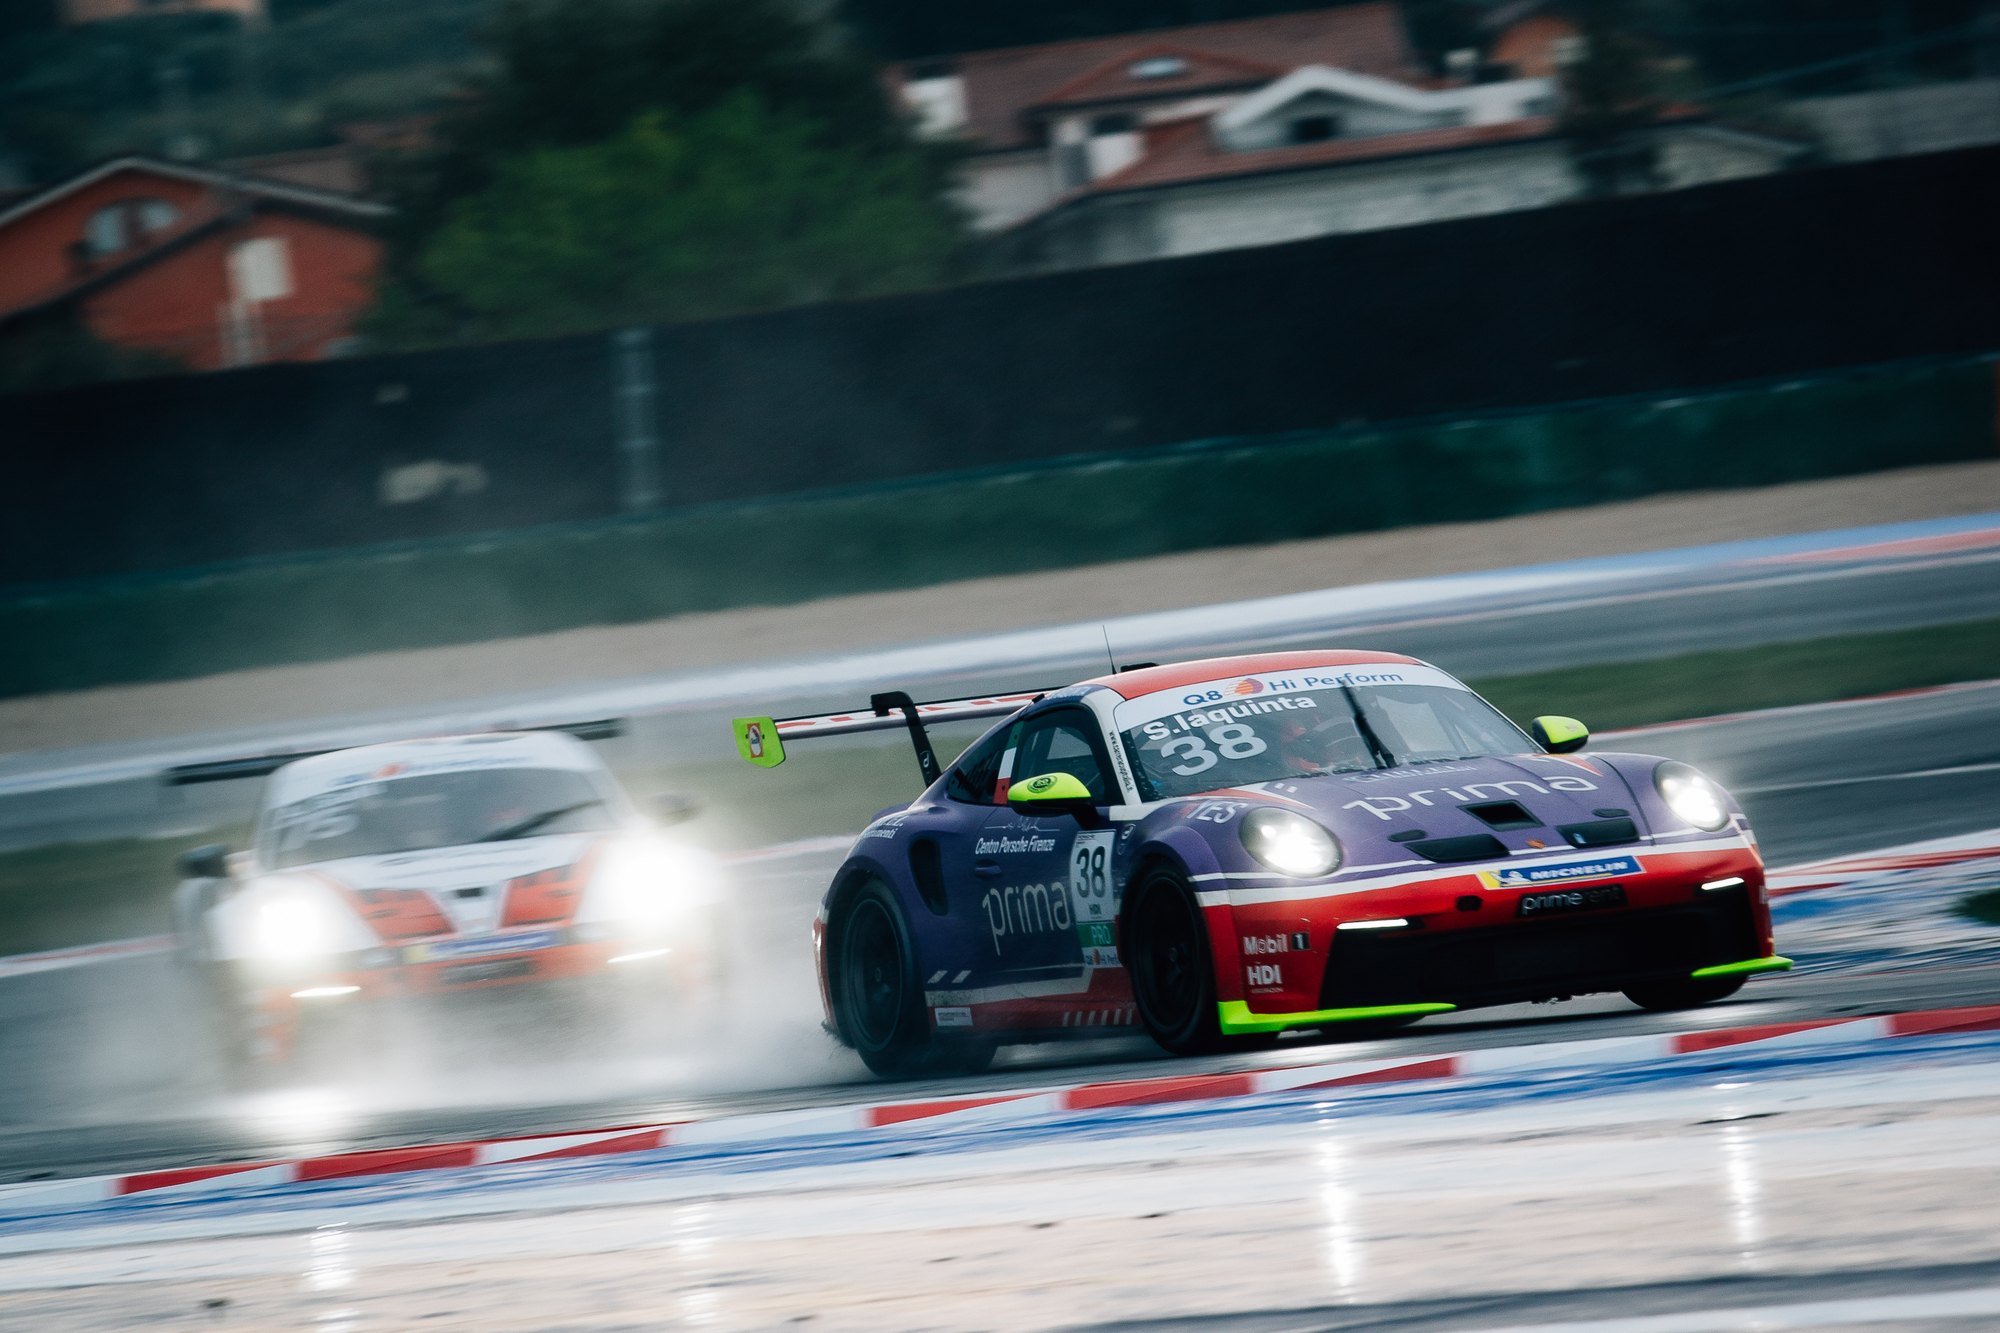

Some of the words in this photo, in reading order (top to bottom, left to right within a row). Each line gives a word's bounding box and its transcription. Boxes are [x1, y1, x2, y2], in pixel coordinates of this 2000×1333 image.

[1183, 689, 1223, 706] Q8
[1268, 678, 1298, 692] Hi
[1303, 670, 1403, 687] Perform
[1160, 724, 1268, 776] 38
[1342, 776, 1599, 821] prima
[975, 837, 1000, 855] Centro
[999, 836, 1029, 854] Porsche
[1028, 835, 1055, 853] Firenze
[1076, 846, 1105, 898] 38
[1530, 861, 1628, 880] MICHELIN
[982, 881, 1071, 956] prima
[1091, 925, 1111, 945] PRO
[1243, 933, 1288, 955] Mobil
[1247, 964, 1283, 986] HDI
